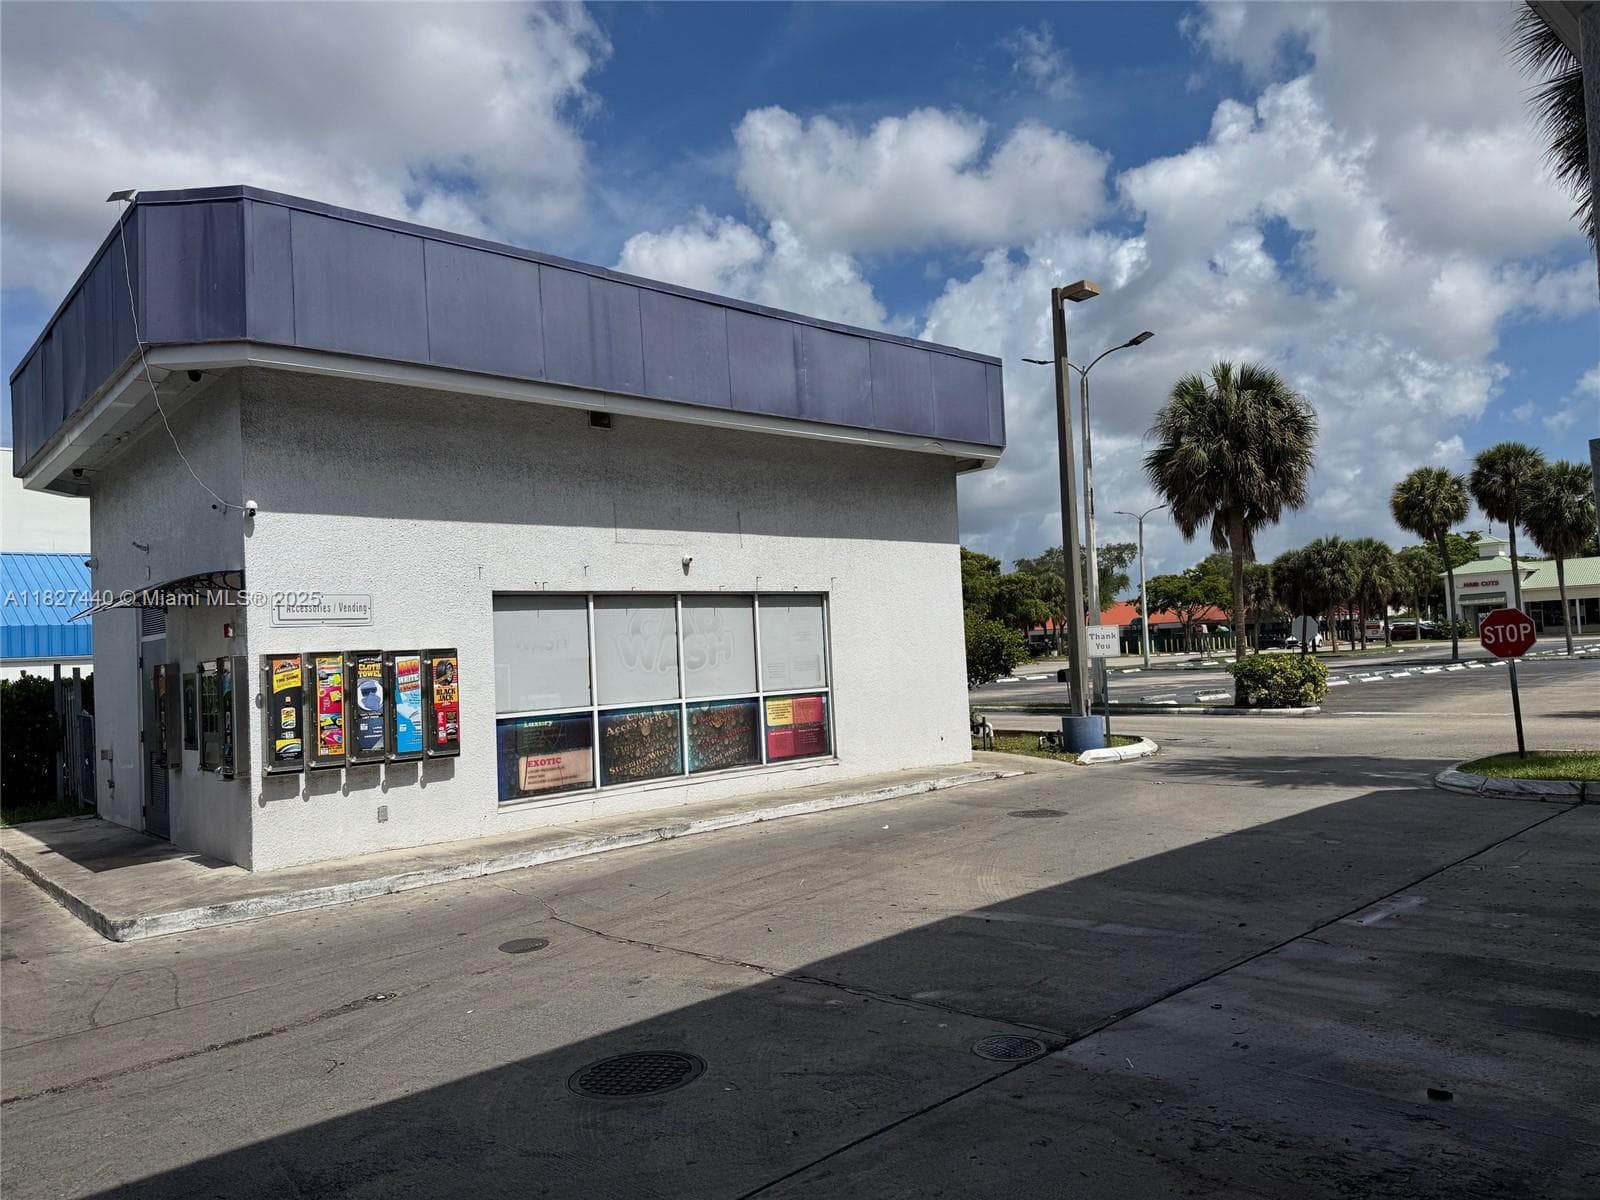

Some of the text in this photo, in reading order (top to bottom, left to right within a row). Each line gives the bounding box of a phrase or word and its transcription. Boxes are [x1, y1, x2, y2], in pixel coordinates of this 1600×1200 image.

[286, 602, 331, 614] Accessories
[338, 601, 368, 615] Vending
[1088, 632, 1117, 640] Thank
[1483, 623, 1532, 644] STOP
[616, 631, 736, 673] WASH
[357, 670, 383, 678] TOWEL
[435, 687, 457, 696] BLACK
[438, 694, 454, 702] JACK
[606, 712, 669, 737] Accessories
[527, 757, 562, 768] EXOTIC
